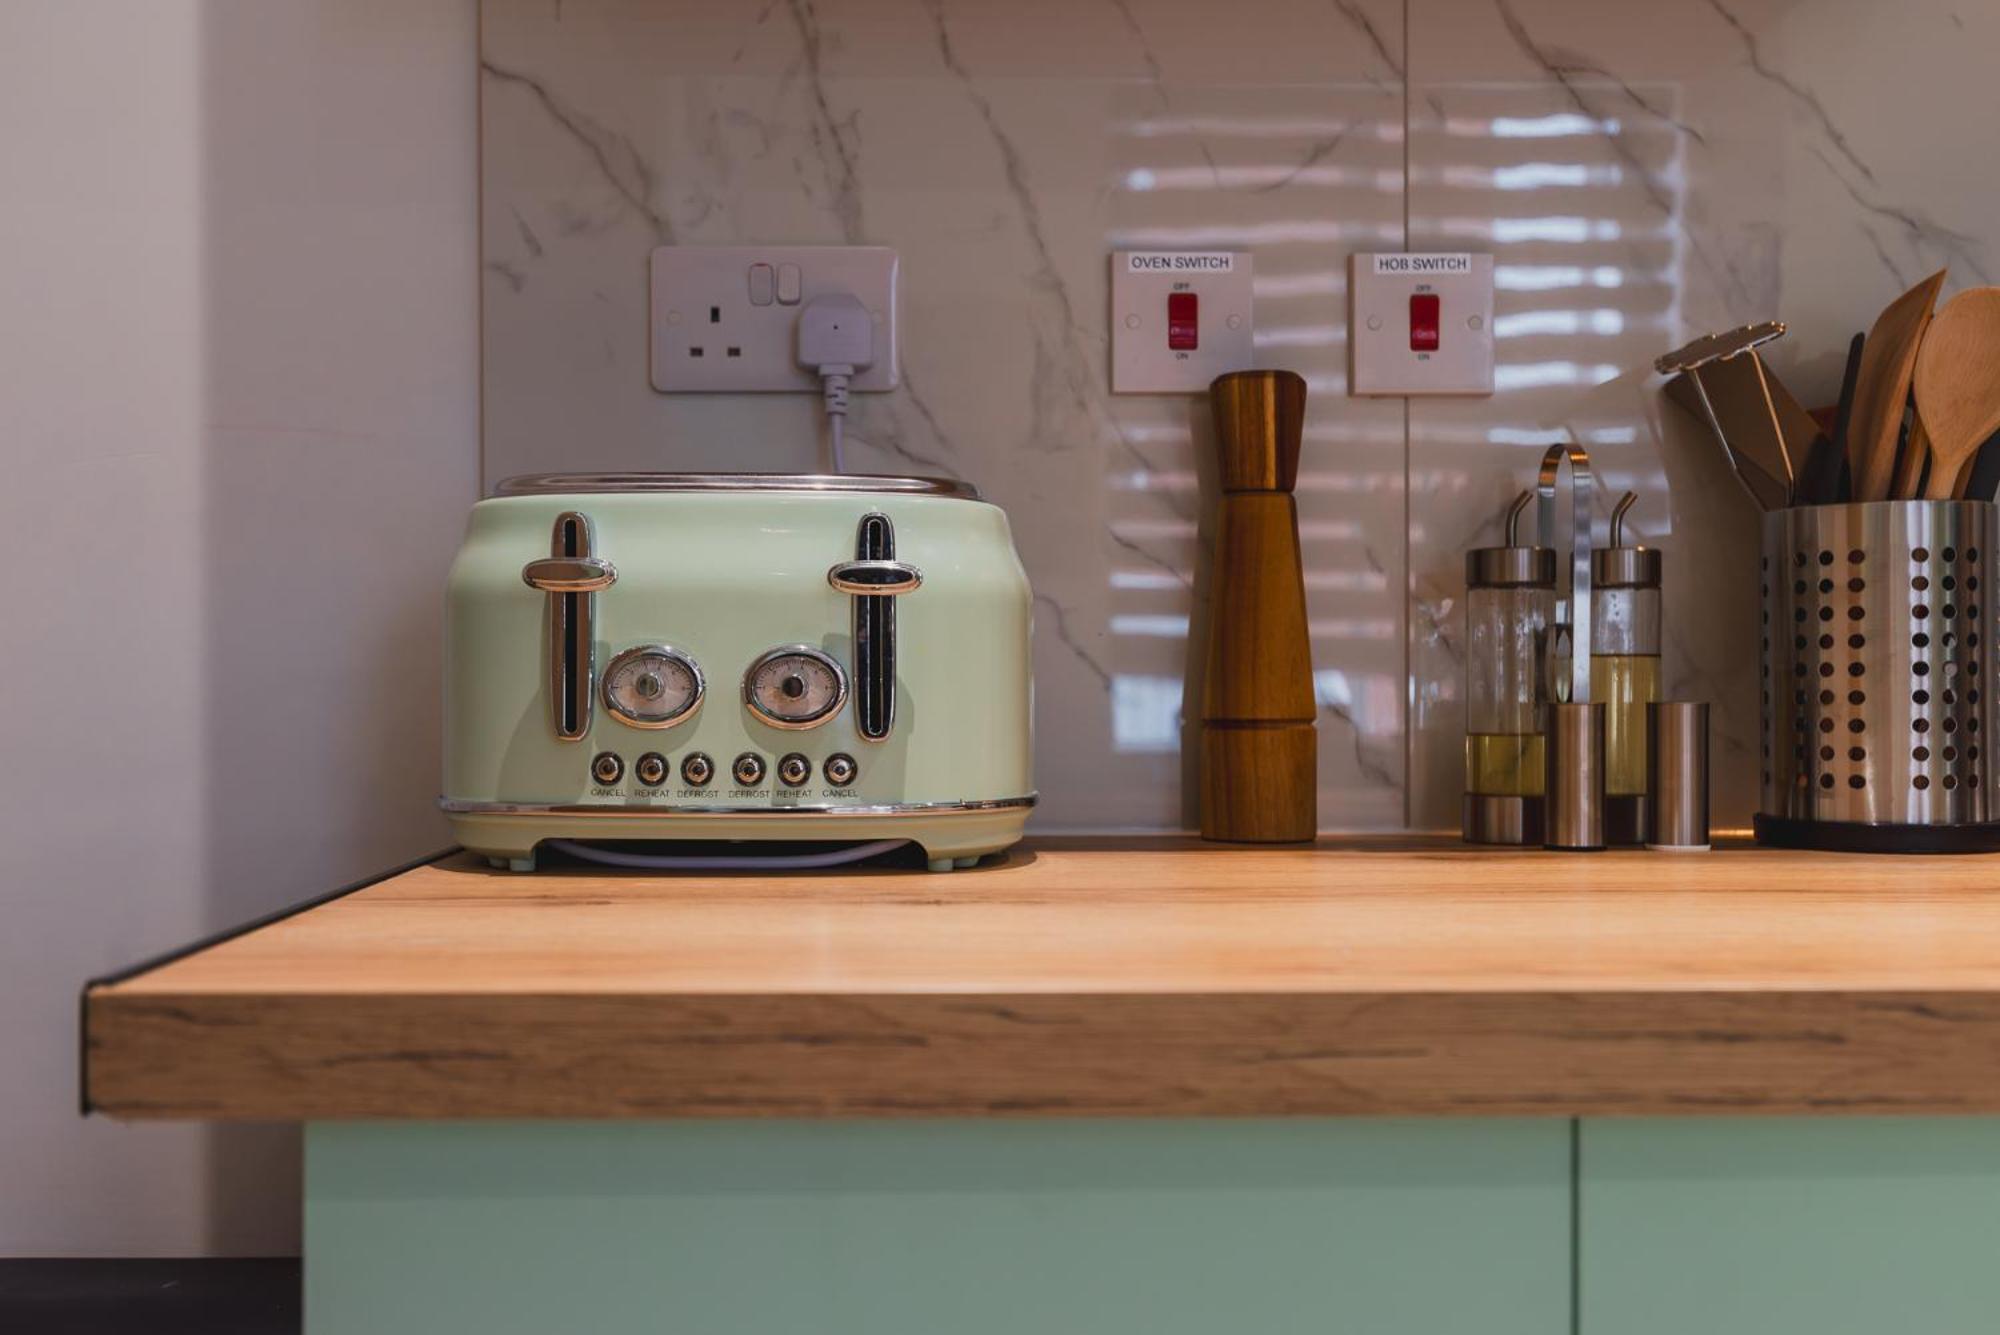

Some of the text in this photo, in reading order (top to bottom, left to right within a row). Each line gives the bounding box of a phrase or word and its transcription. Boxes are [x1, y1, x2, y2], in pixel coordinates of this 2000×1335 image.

[1131, 256, 1230, 269] OVEN SWITCH
[1379, 257, 1467, 270] HOB SWITCH
[590, 788, 625, 797] CANCEL
[634, 789, 669, 798] REHEAT
[677, 789, 720, 799] DEFROST
[728, 789, 770, 799] DEFROST
[776, 789, 812, 799] REHEAT
[822, 788, 858, 798] CANCEL
